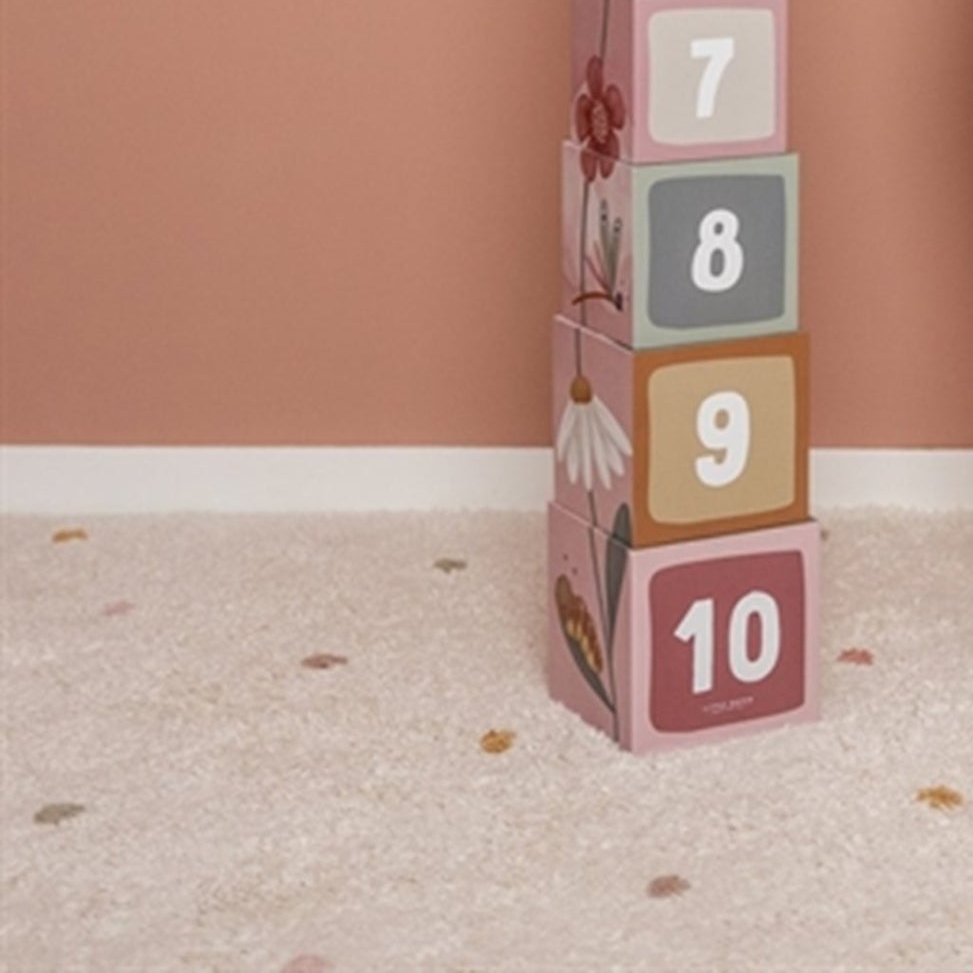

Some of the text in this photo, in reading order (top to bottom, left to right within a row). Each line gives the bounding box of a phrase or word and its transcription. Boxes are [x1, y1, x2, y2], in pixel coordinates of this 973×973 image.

[691, 37, 734, 117] 7
[692, 209, 743, 291] 8
[696, 392, 749, 486] 9
[674, 591, 780, 693] 10
